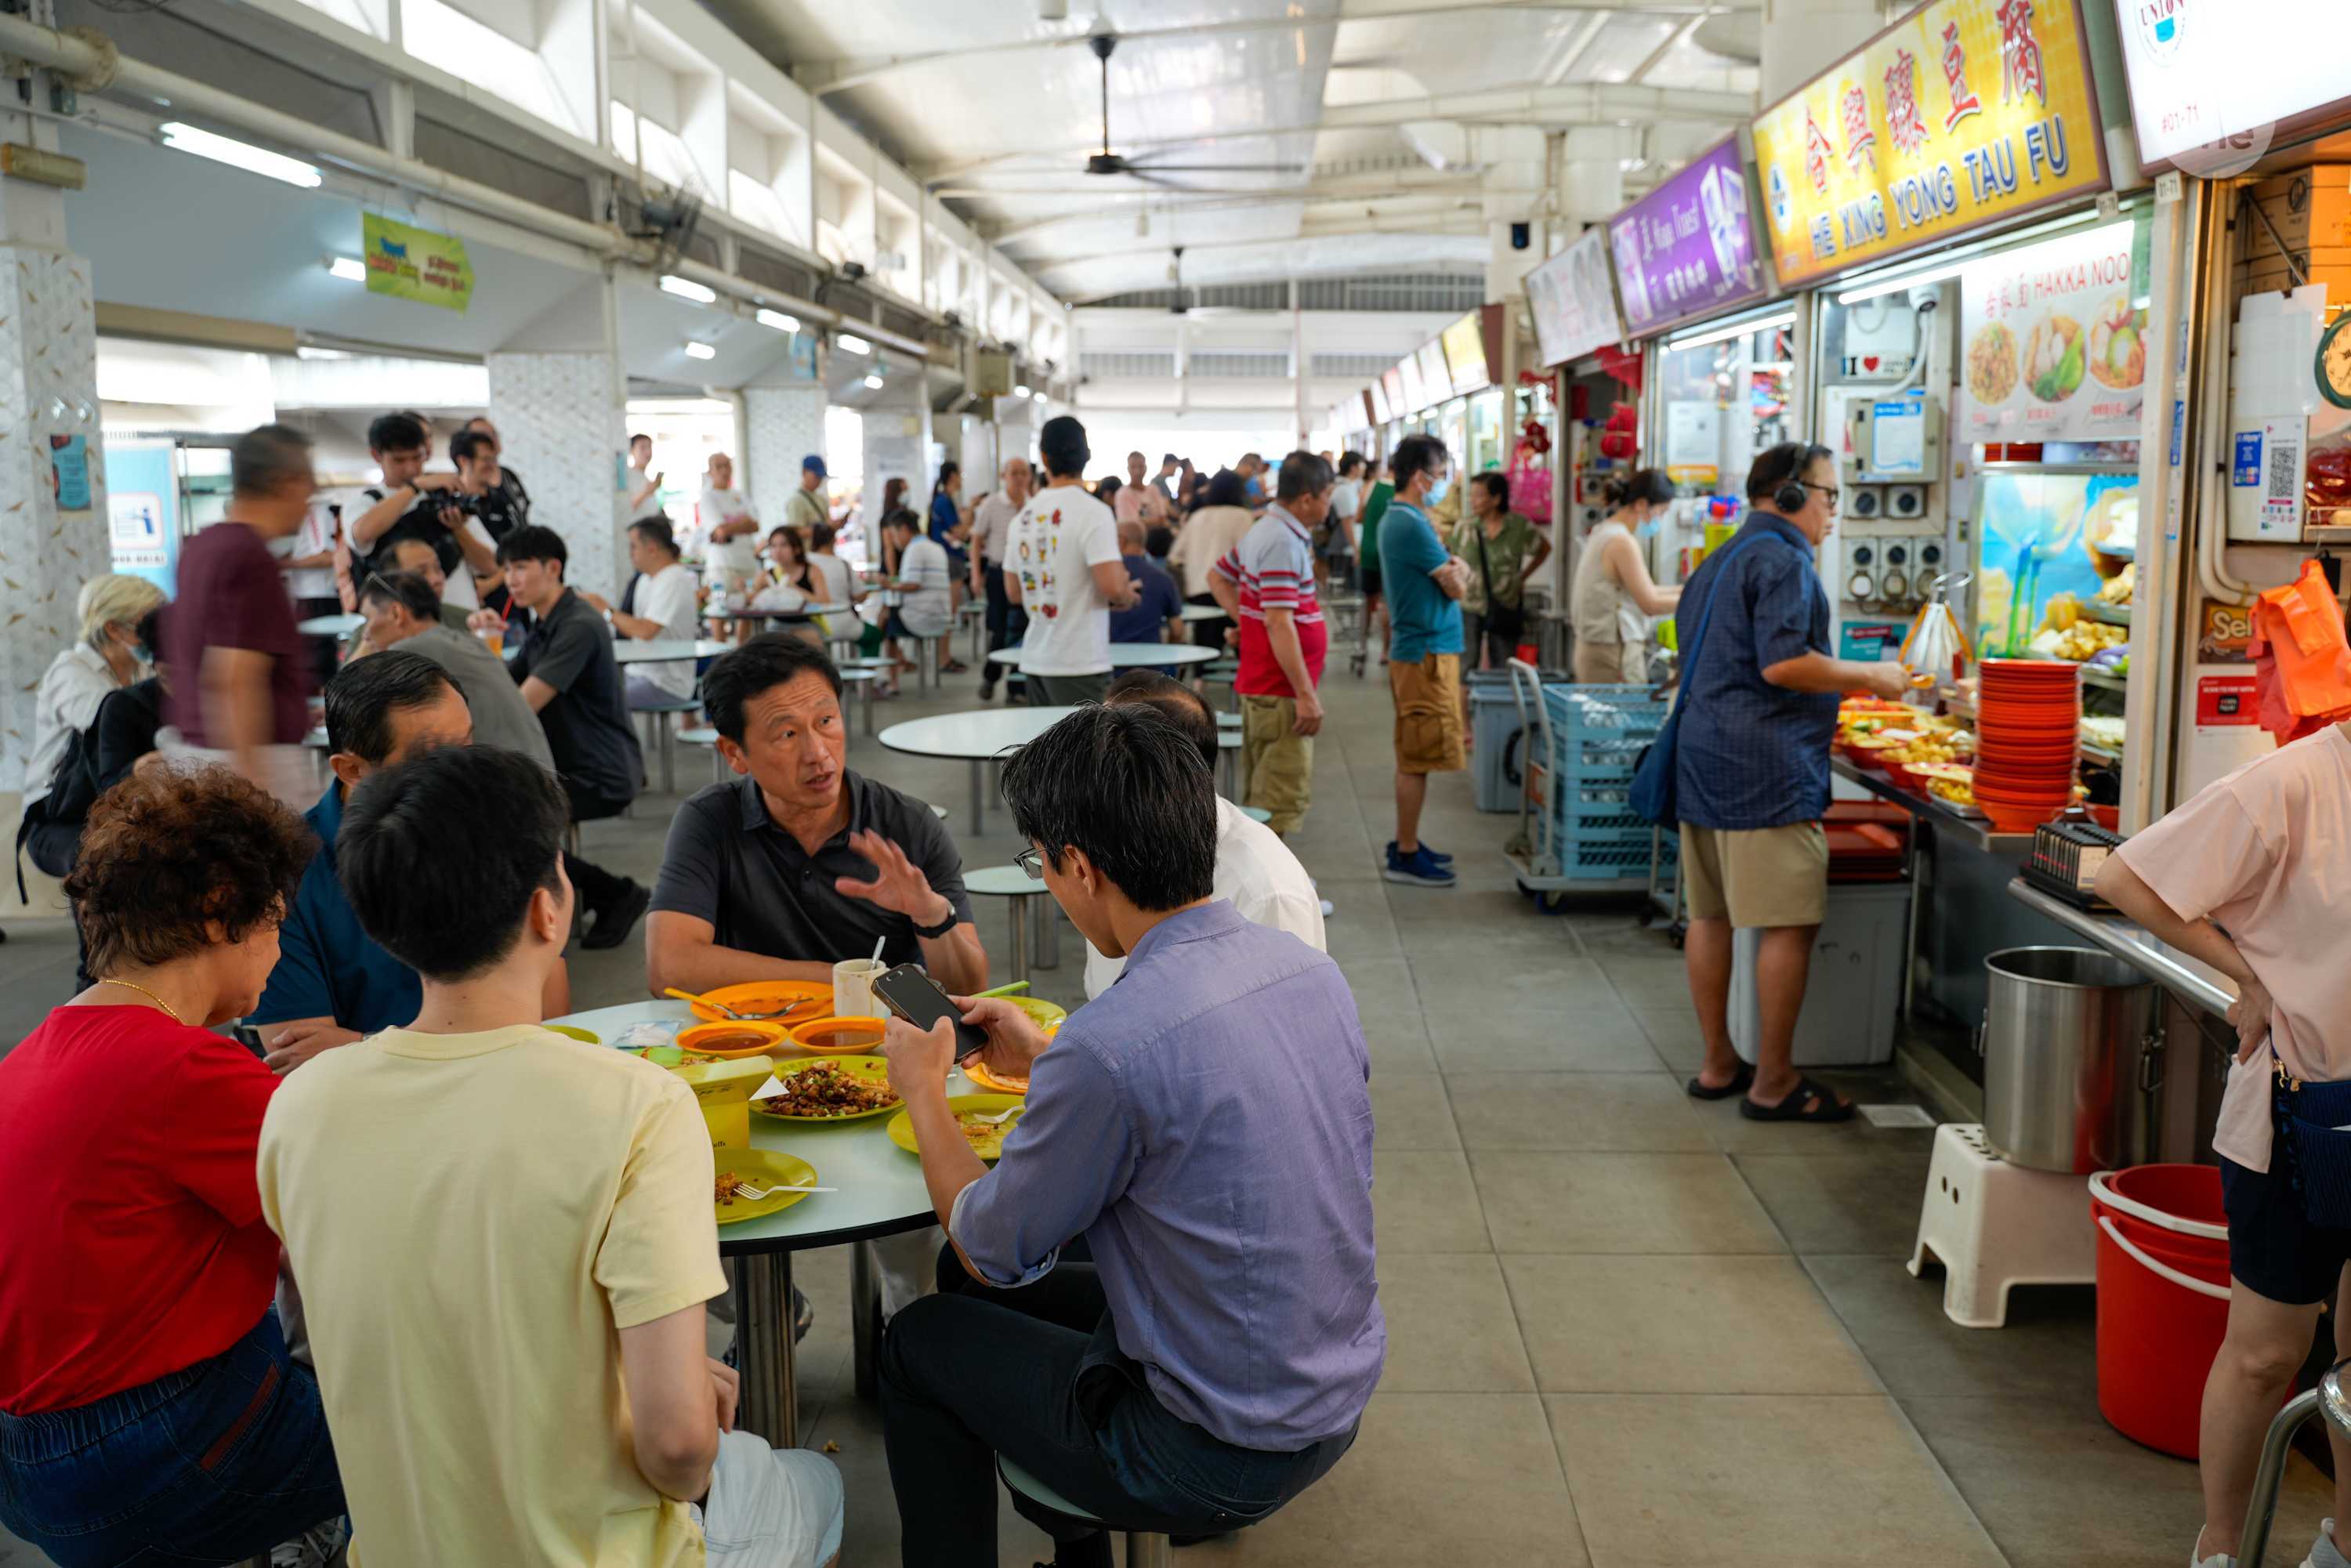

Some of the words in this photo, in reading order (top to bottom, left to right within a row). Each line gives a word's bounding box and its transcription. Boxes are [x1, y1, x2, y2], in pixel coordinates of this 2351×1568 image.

[1809, 212, 1837, 260] HE
[1838, 190, 1888, 250] XING
[1889, 161, 1958, 229] YONG
[1963, 135, 2018, 205] TAU
[2025, 113, 2070, 184] FU
[2034, 263, 2088, 300] HAKKA
[2092, 252, 2132, 287] NOO
[1849, 357, 1857, 375] I
[2212, 610, 2252, 640] Sel
